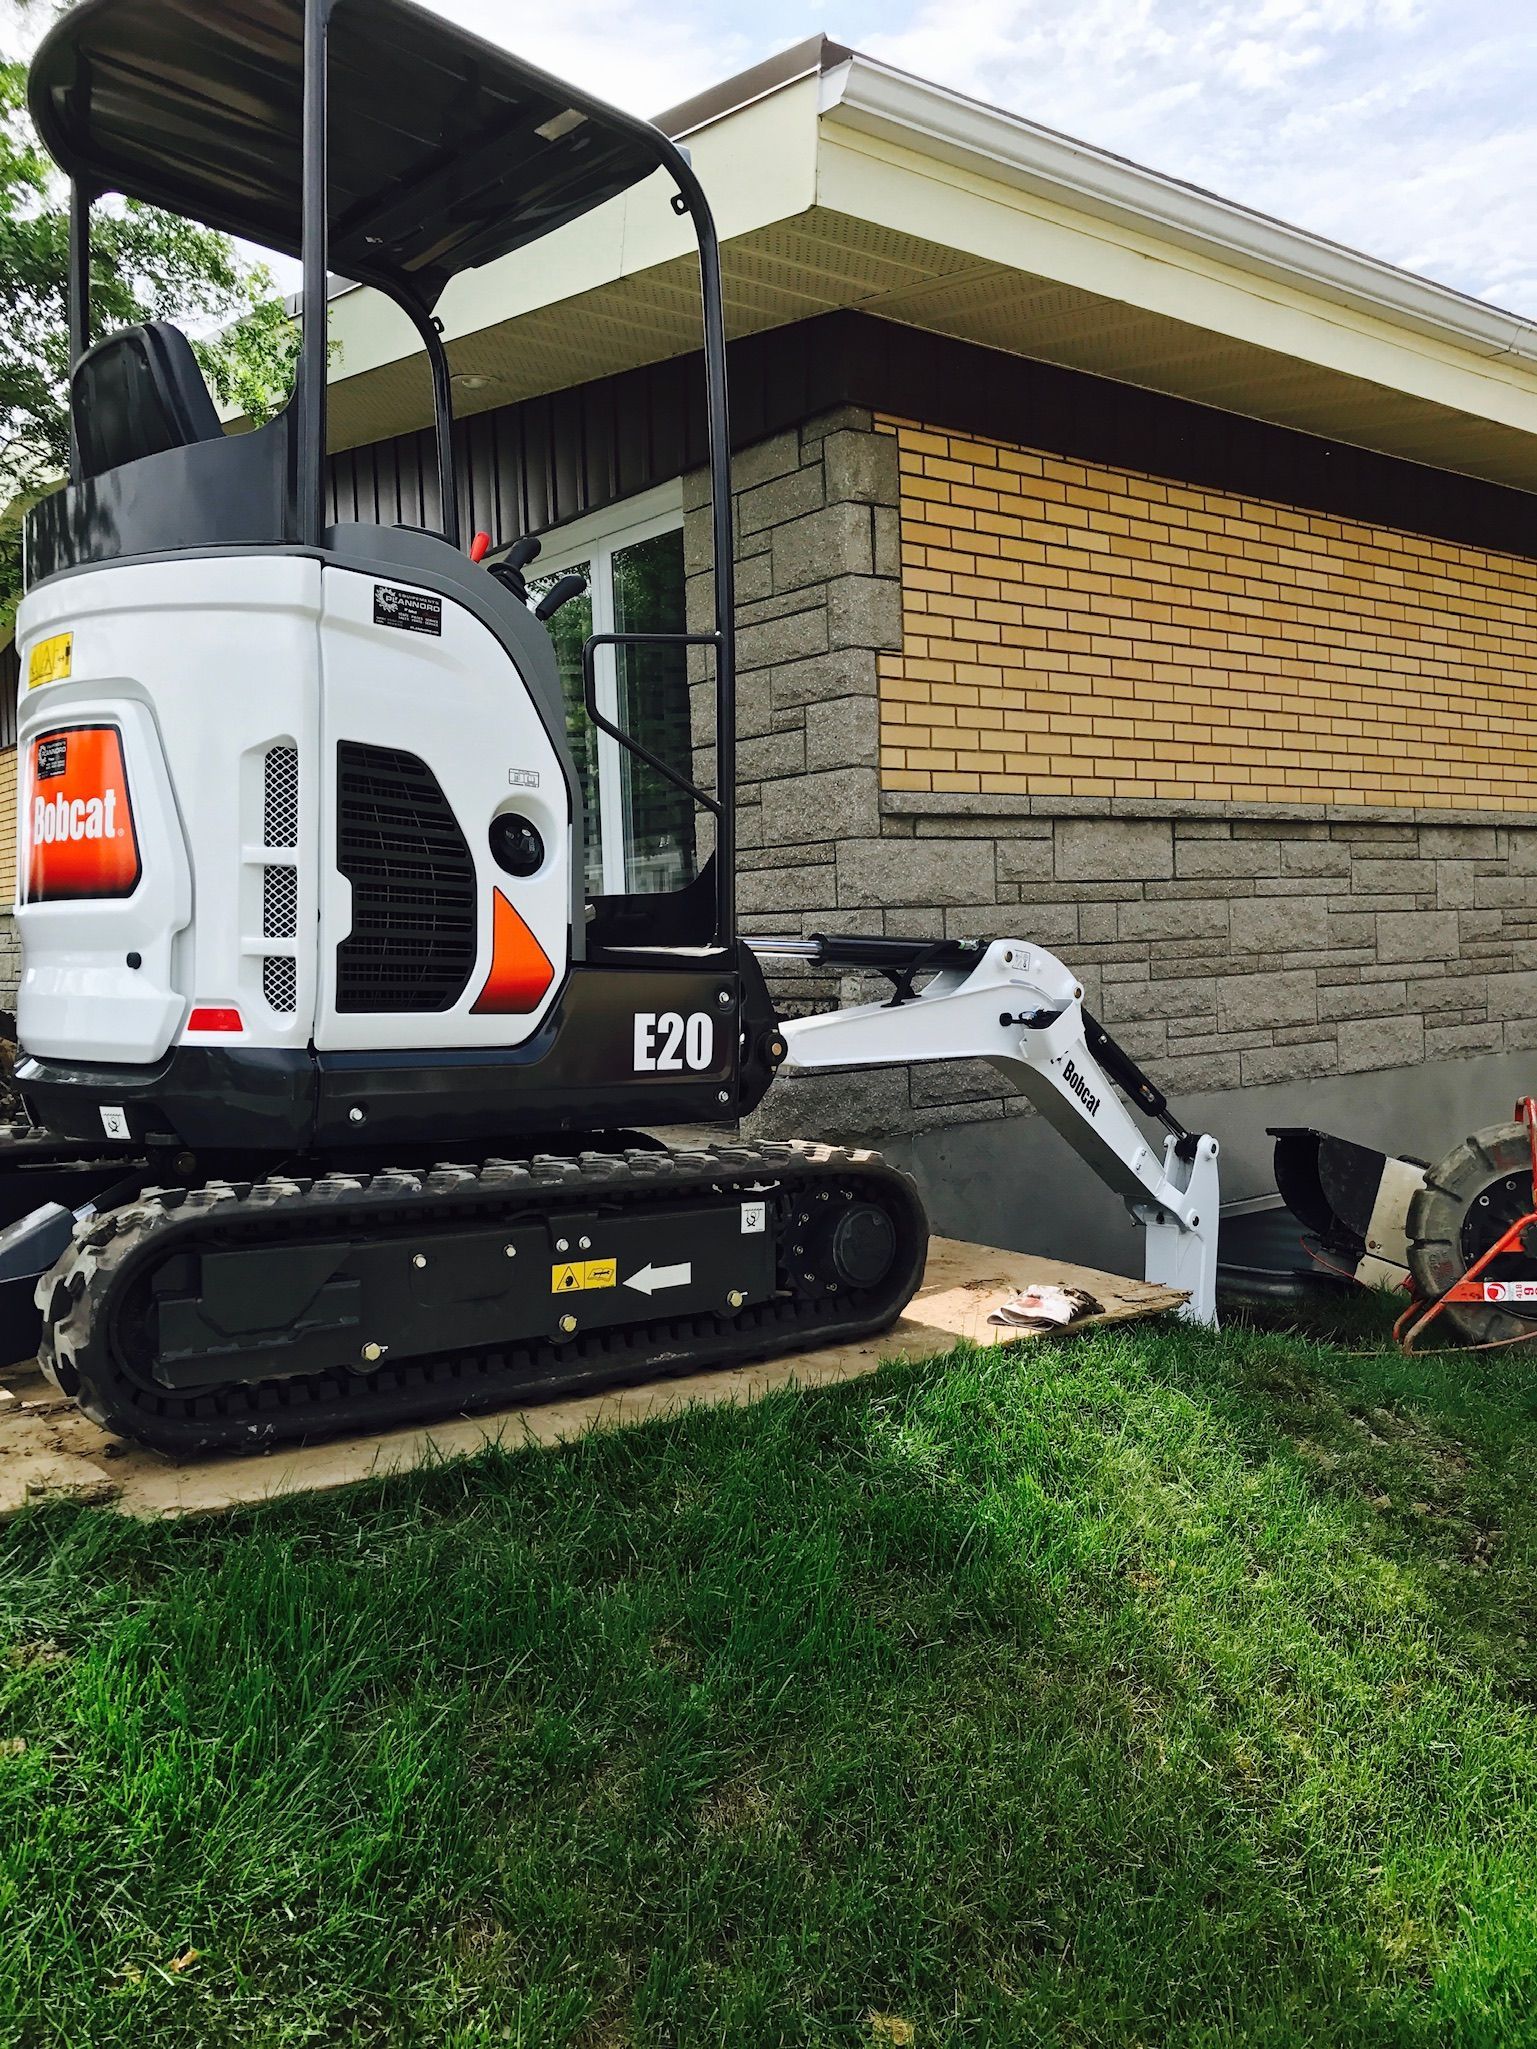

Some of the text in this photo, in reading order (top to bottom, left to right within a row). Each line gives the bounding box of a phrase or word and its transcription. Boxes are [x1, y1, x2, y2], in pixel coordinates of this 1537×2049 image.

[385, 595, 441, 613] PLANNORD
[34, 788, 116, 845] Bobcat
[633, 1011, 714, 1071] E20
[1062, 1059, 1101, 1117] Bobcat
